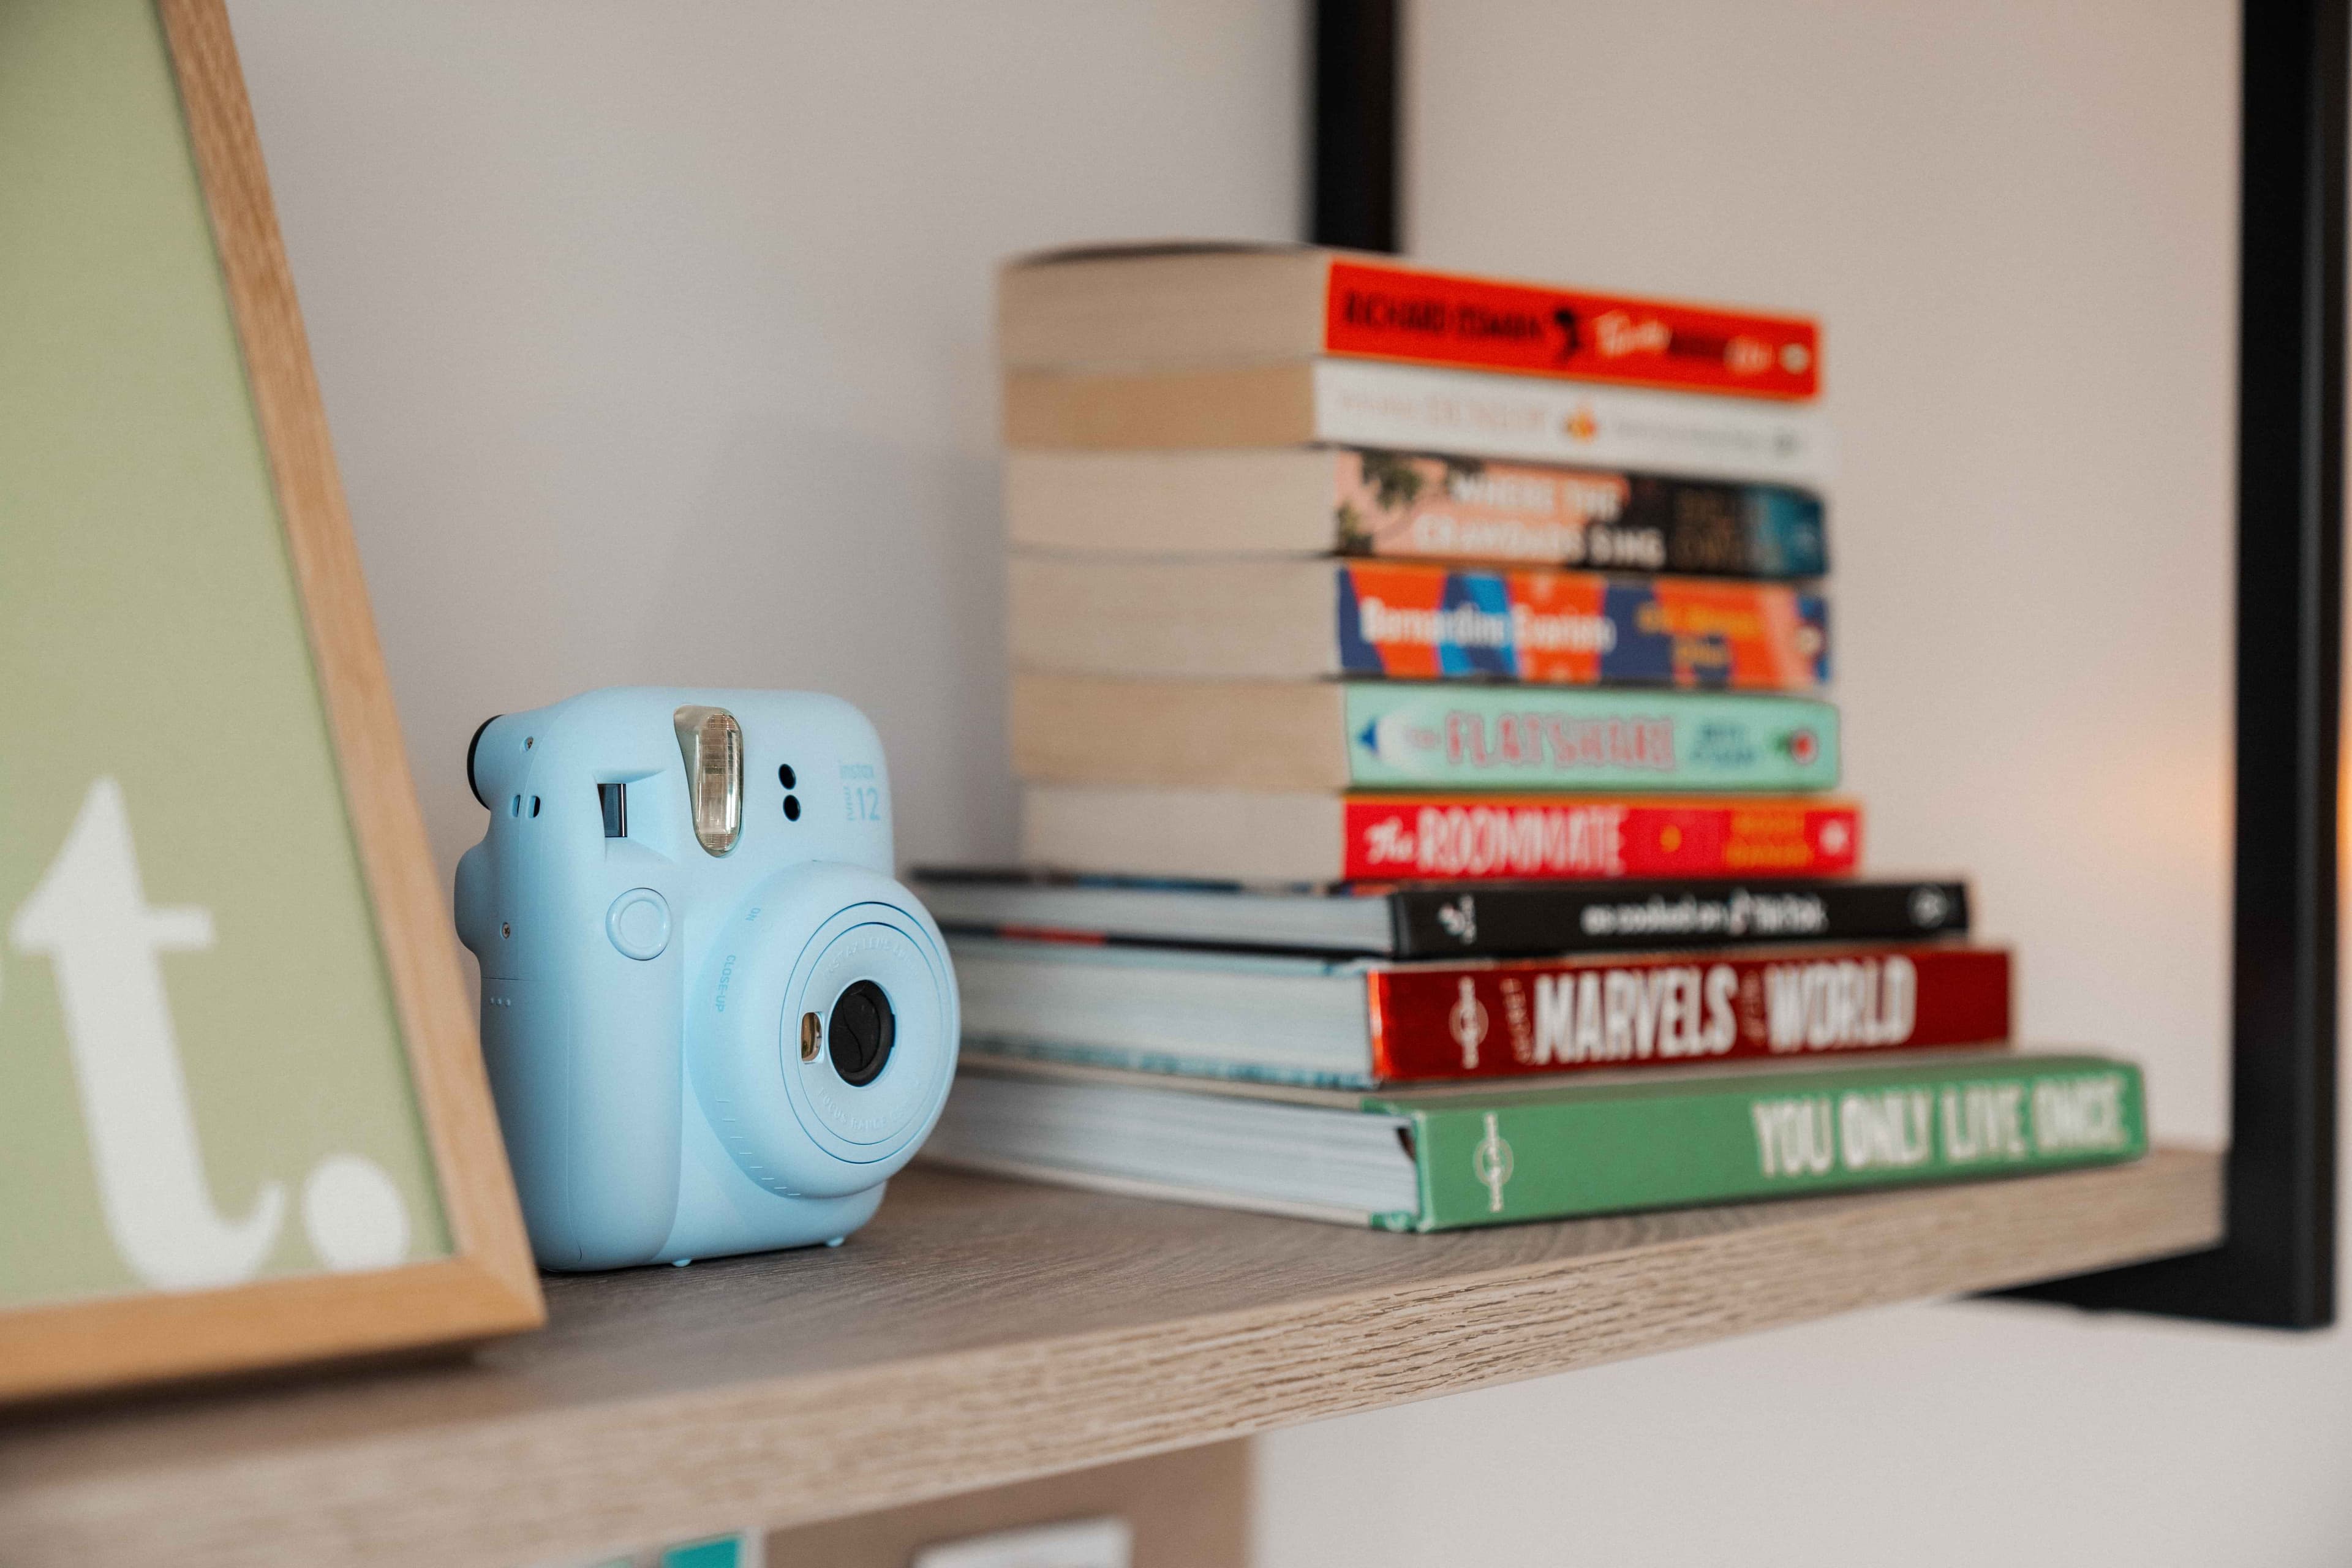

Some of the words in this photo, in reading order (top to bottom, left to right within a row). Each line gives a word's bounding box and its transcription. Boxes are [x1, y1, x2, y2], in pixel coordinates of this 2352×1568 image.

[1589, 523, 1665, 568] SING
[1445, 709, 1676, 772] FLATSHARE
[856, 786, 881, 821] 12
[1363, 815, 1414, 864] The
[1416, 805, 1630, 876] ROOMMATE
[745, 907, 761, 921] ON
[715, 954, 736, 1012] CLOSE-UP
[1534, 963, 1738, 1065] MARVELS
[1764, 955, 1918, 1054] WORLD
[1753, 1099, 1833, 1175] YOU
[1841, 1089, 1932, 1170] ONLY
[1941, 1083, 2024, 1159] LIVE
